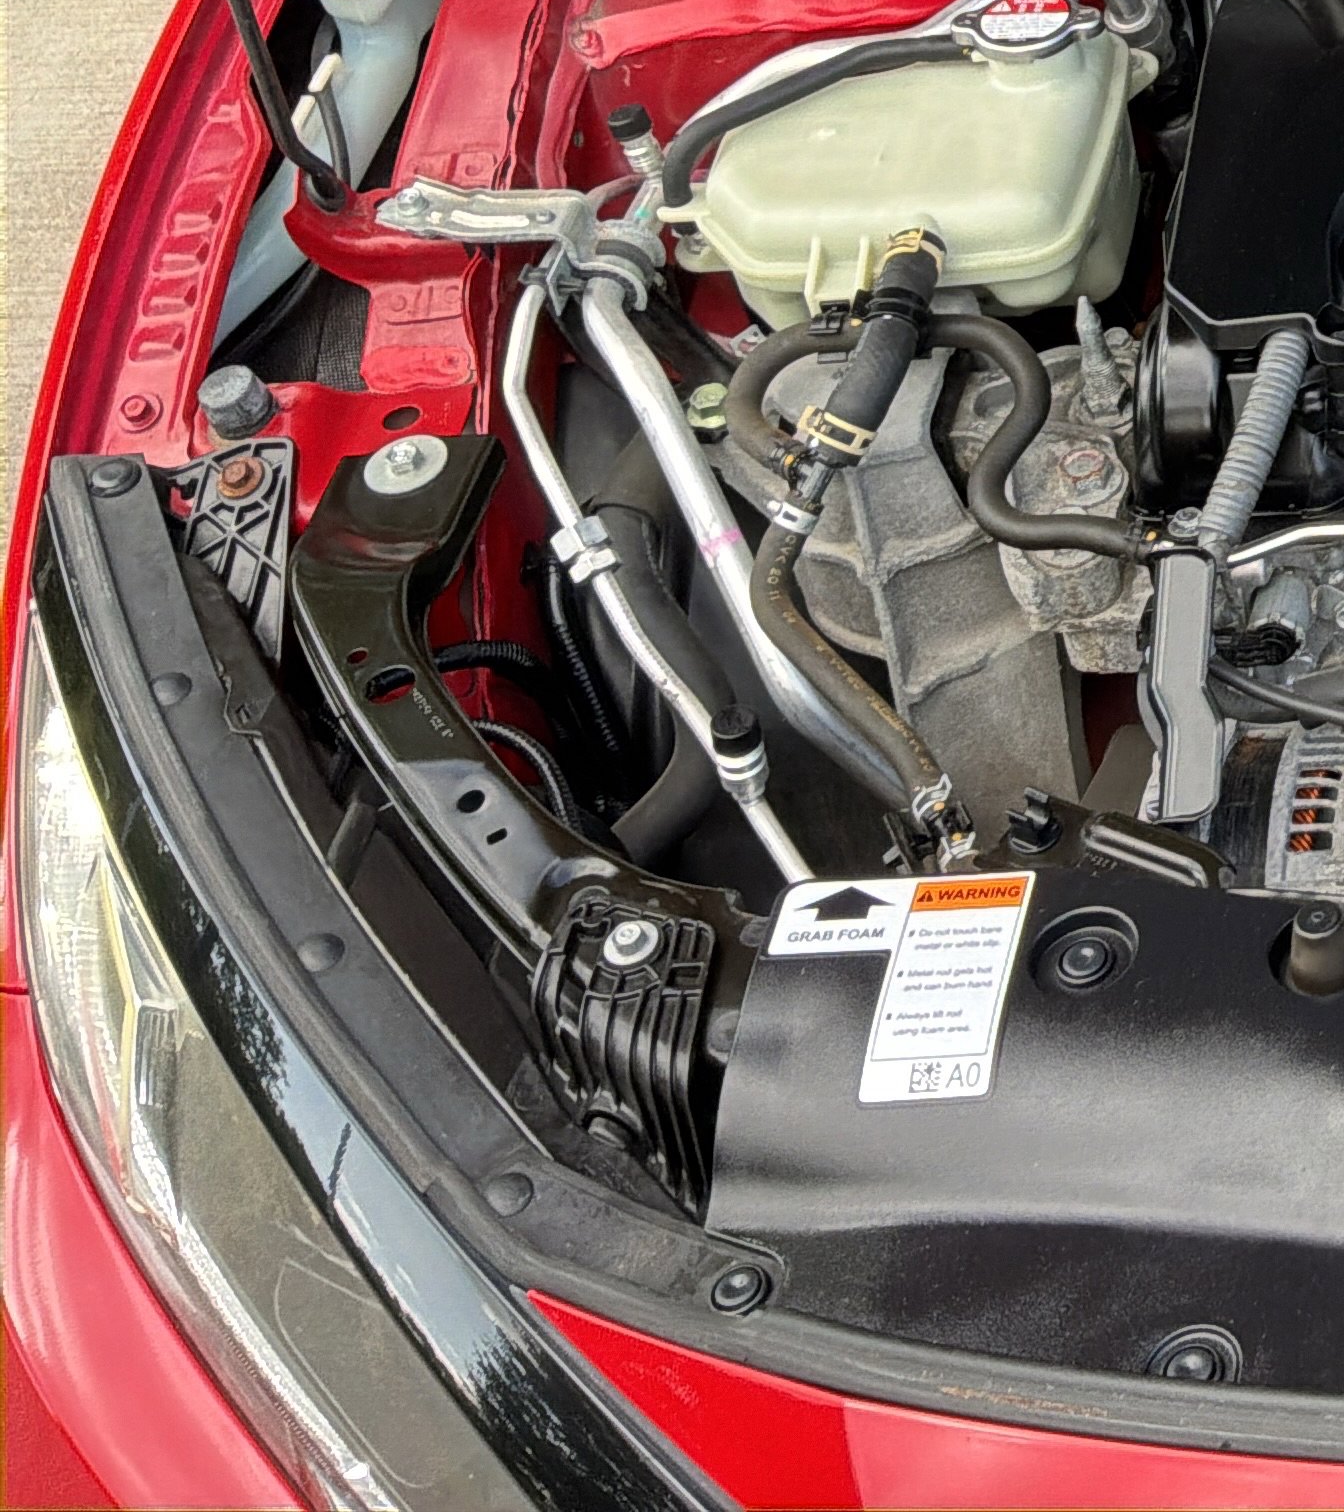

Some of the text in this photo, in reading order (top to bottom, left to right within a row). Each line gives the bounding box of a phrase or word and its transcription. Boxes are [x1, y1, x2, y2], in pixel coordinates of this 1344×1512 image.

[937, 885, 1021, 901] WARNING
[787, 928, 886, 943] GRAB FOAM
